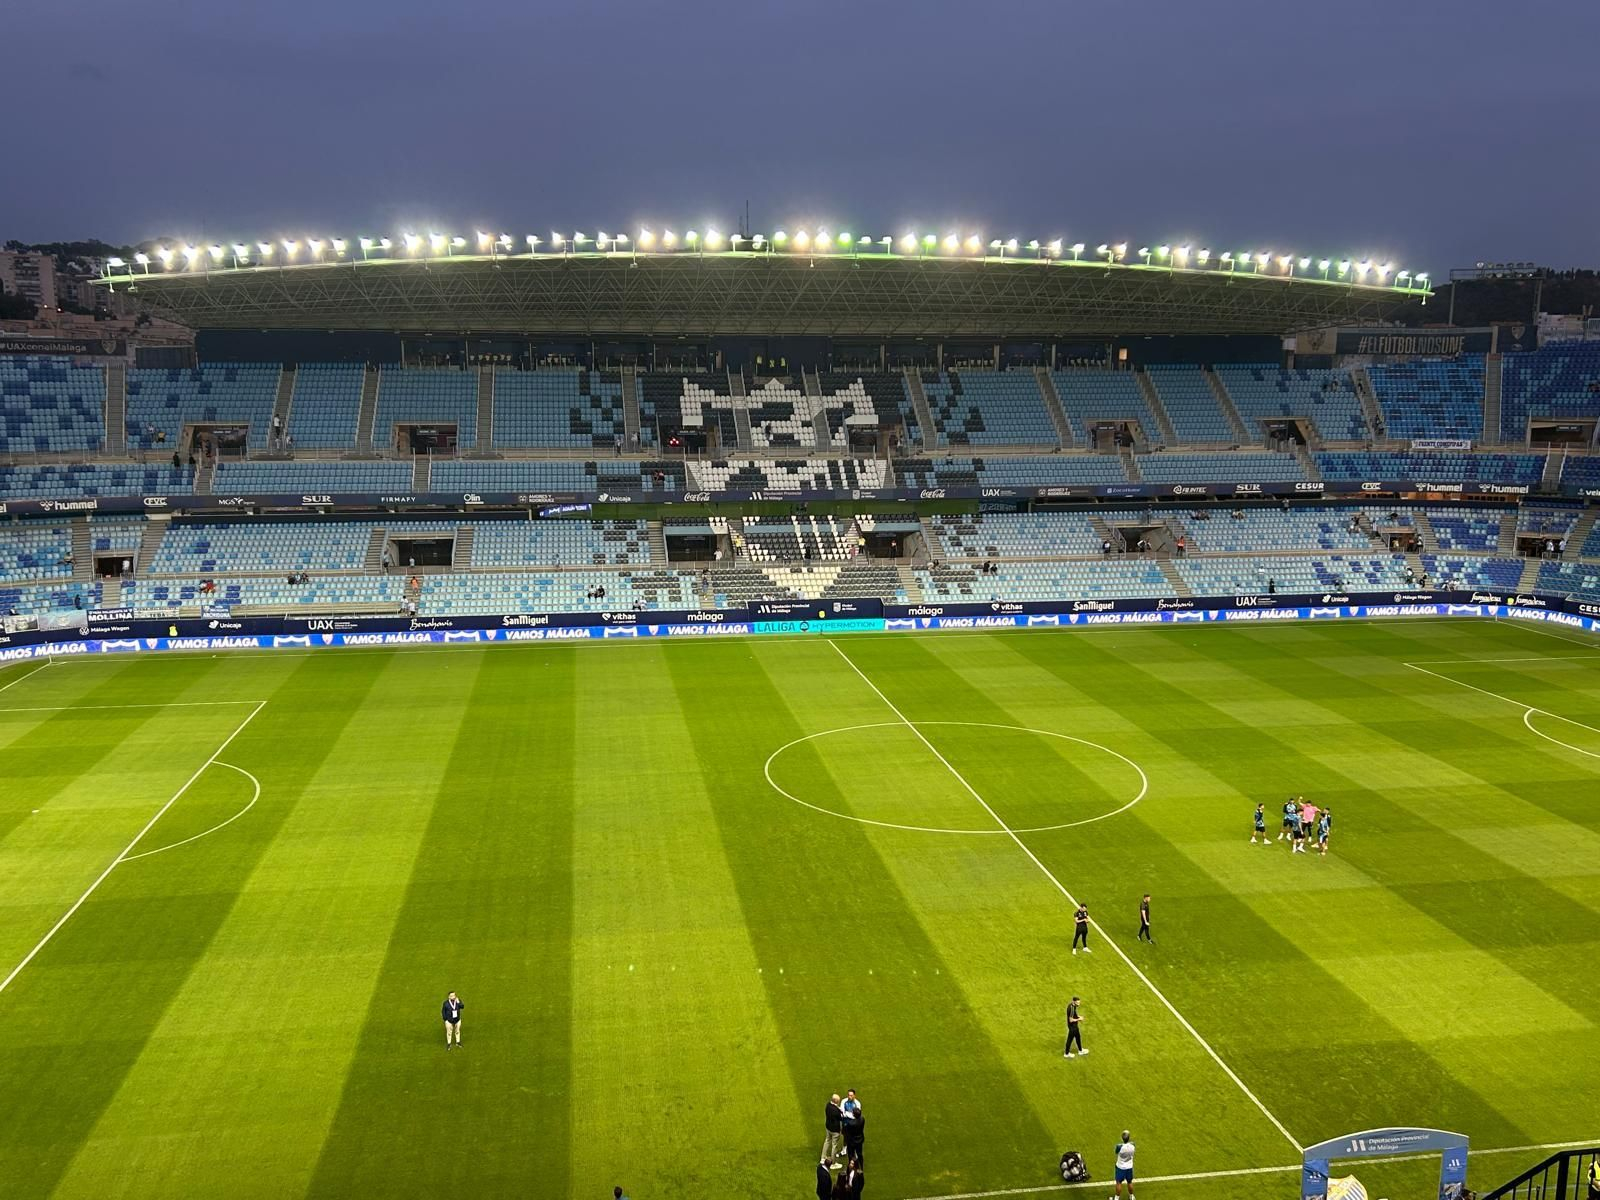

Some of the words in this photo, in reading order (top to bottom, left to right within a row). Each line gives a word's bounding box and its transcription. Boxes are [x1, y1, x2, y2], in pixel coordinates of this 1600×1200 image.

[1295, 482, 1325, 490] CESUR
[1426, 483, 1463, 491] hummel
[1491, 485, 1529, 494] hummel
[463, 494, 481, 502] Olin
[982, 489, 1000, 497] UAX
[54, 498, 98, 511] hummel
[1236, 596, 1257, 606] UAX
[1366, 607, 1398, 616] VAMOS
[1399, 605, 1438, 614] MÁLAGA
[1578, 604, 1600, 613] CES
[88, 612, 133, 622] MOLLINA
[1087, 614, 1122, 624] VAMOS
[1123, 612, 1162, 622] MÁLAGA
[1225, 612, 1259, 620] VAMOS
[1260, 608, 1299, 618] MÁLAGA
[1507, 608, 1546, 620] VAMOS
[1546, 612, 1584, 627] MÁLAGA
[308, 620, 334, 630] UAX
[757, 622, 796, 632] LALIGA
[938, 618, 974, 628] VAMOS
[974, 616, 1016, 626] MÁLAGA
[506, 630, 544, 640] VAMOS
[546, 628, 590, 638] MÁLAGA
[667, 626, 704, 635] VAMOS
[706, 624, 748, 634] MÁLAGA
[166, 639, 208, 650] VAMOS
[211, 636, 259, 648] MÁLAGA
[342, 635, 384, 644] VAMOS
[385, 632, 432, 643] MÁLAGA
[0, 648, 32, 660] AMOS
[34, 642, 88, 657] MÁLAGA
[1368, 1137, 1400, 1146] Diputación
[1376, 1144, 1398, 1152] Málaga
